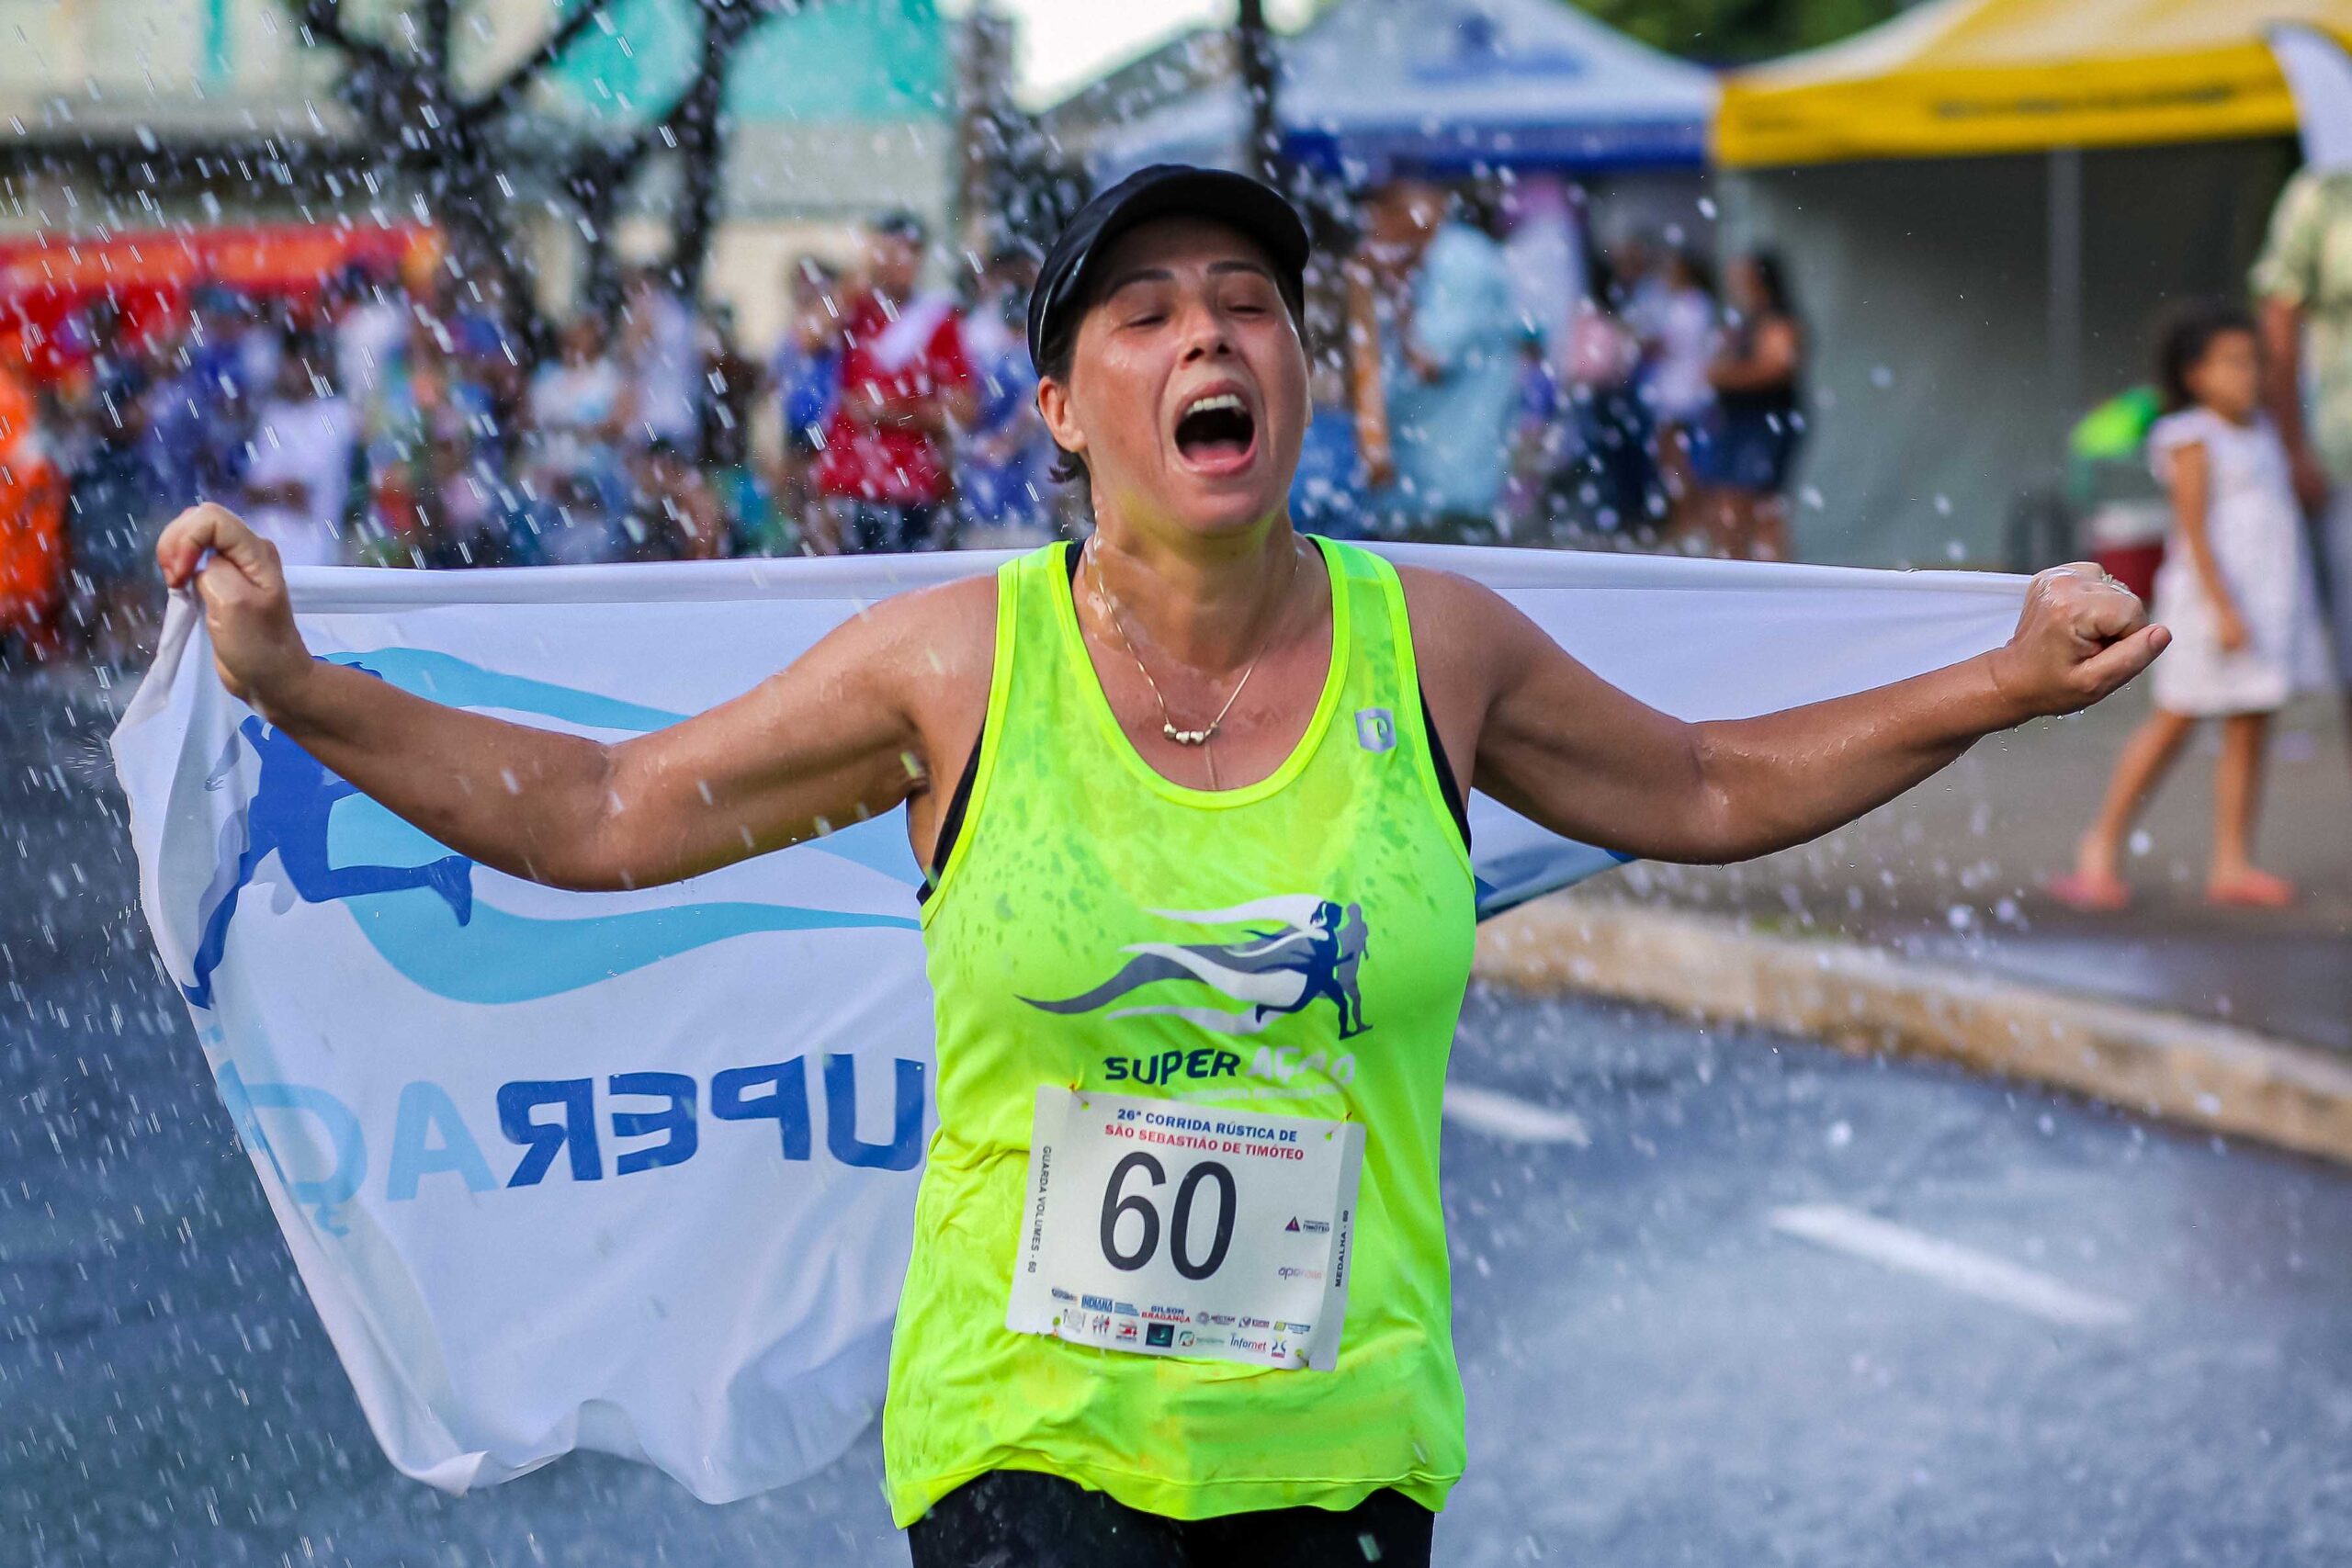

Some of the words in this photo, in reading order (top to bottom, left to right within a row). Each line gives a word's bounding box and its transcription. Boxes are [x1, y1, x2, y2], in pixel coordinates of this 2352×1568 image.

[1105, 1122, 1134, 1138] SÃO
[1138, 1129, 1217, 1151] SEBASTIÃO
[1222, 1141, 1241, 1154] DE
[1245, 1143, 1304, 1160] TIMÓTEO
[1146, 1112, 1211, 1132] CORRIDA
[1216, 1121, 1274, 1140] RÚSTICA
[1279, 1130, 1297, 1142] DE
[1039, 1145, 1052, 1193] GUARDA
[1031, 1196, 1046, 1251] VOLUMES
[1100, 1151, 1237, 1280] 60
[1028, 1261, 1036, 1273] 60
[1335, 1232, 1347, 1287] MEDALHA
[1342, 1210, 1349, 1223] 60
[1141, 1311, 1191, 1324] BRAGANÇA
[1150, 1305, 1184, 1315] GILSON
